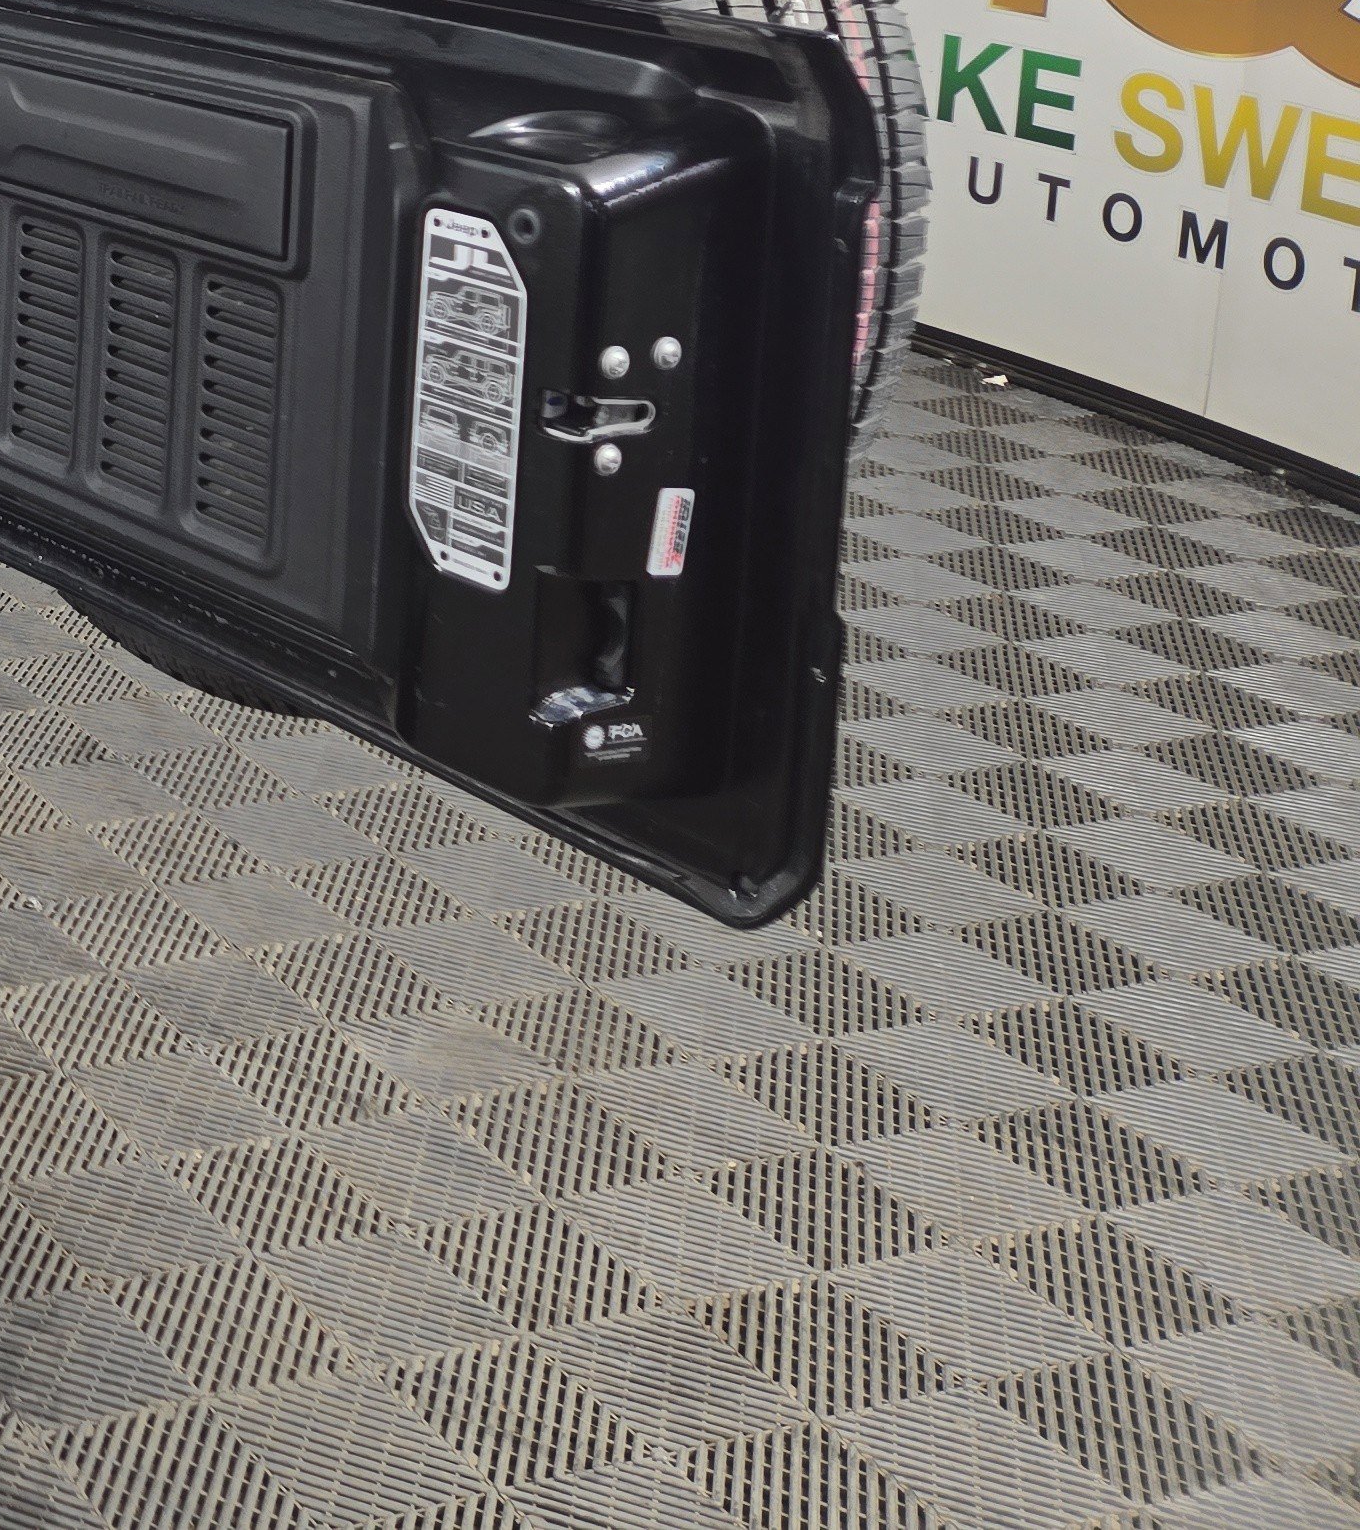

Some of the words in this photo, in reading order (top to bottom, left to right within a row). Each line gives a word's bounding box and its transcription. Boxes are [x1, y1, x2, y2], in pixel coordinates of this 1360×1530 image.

[912, 34, 1083, 152] KE
[457, 496, 503, 523] USA
[608, 723, 643, 739] FCA
